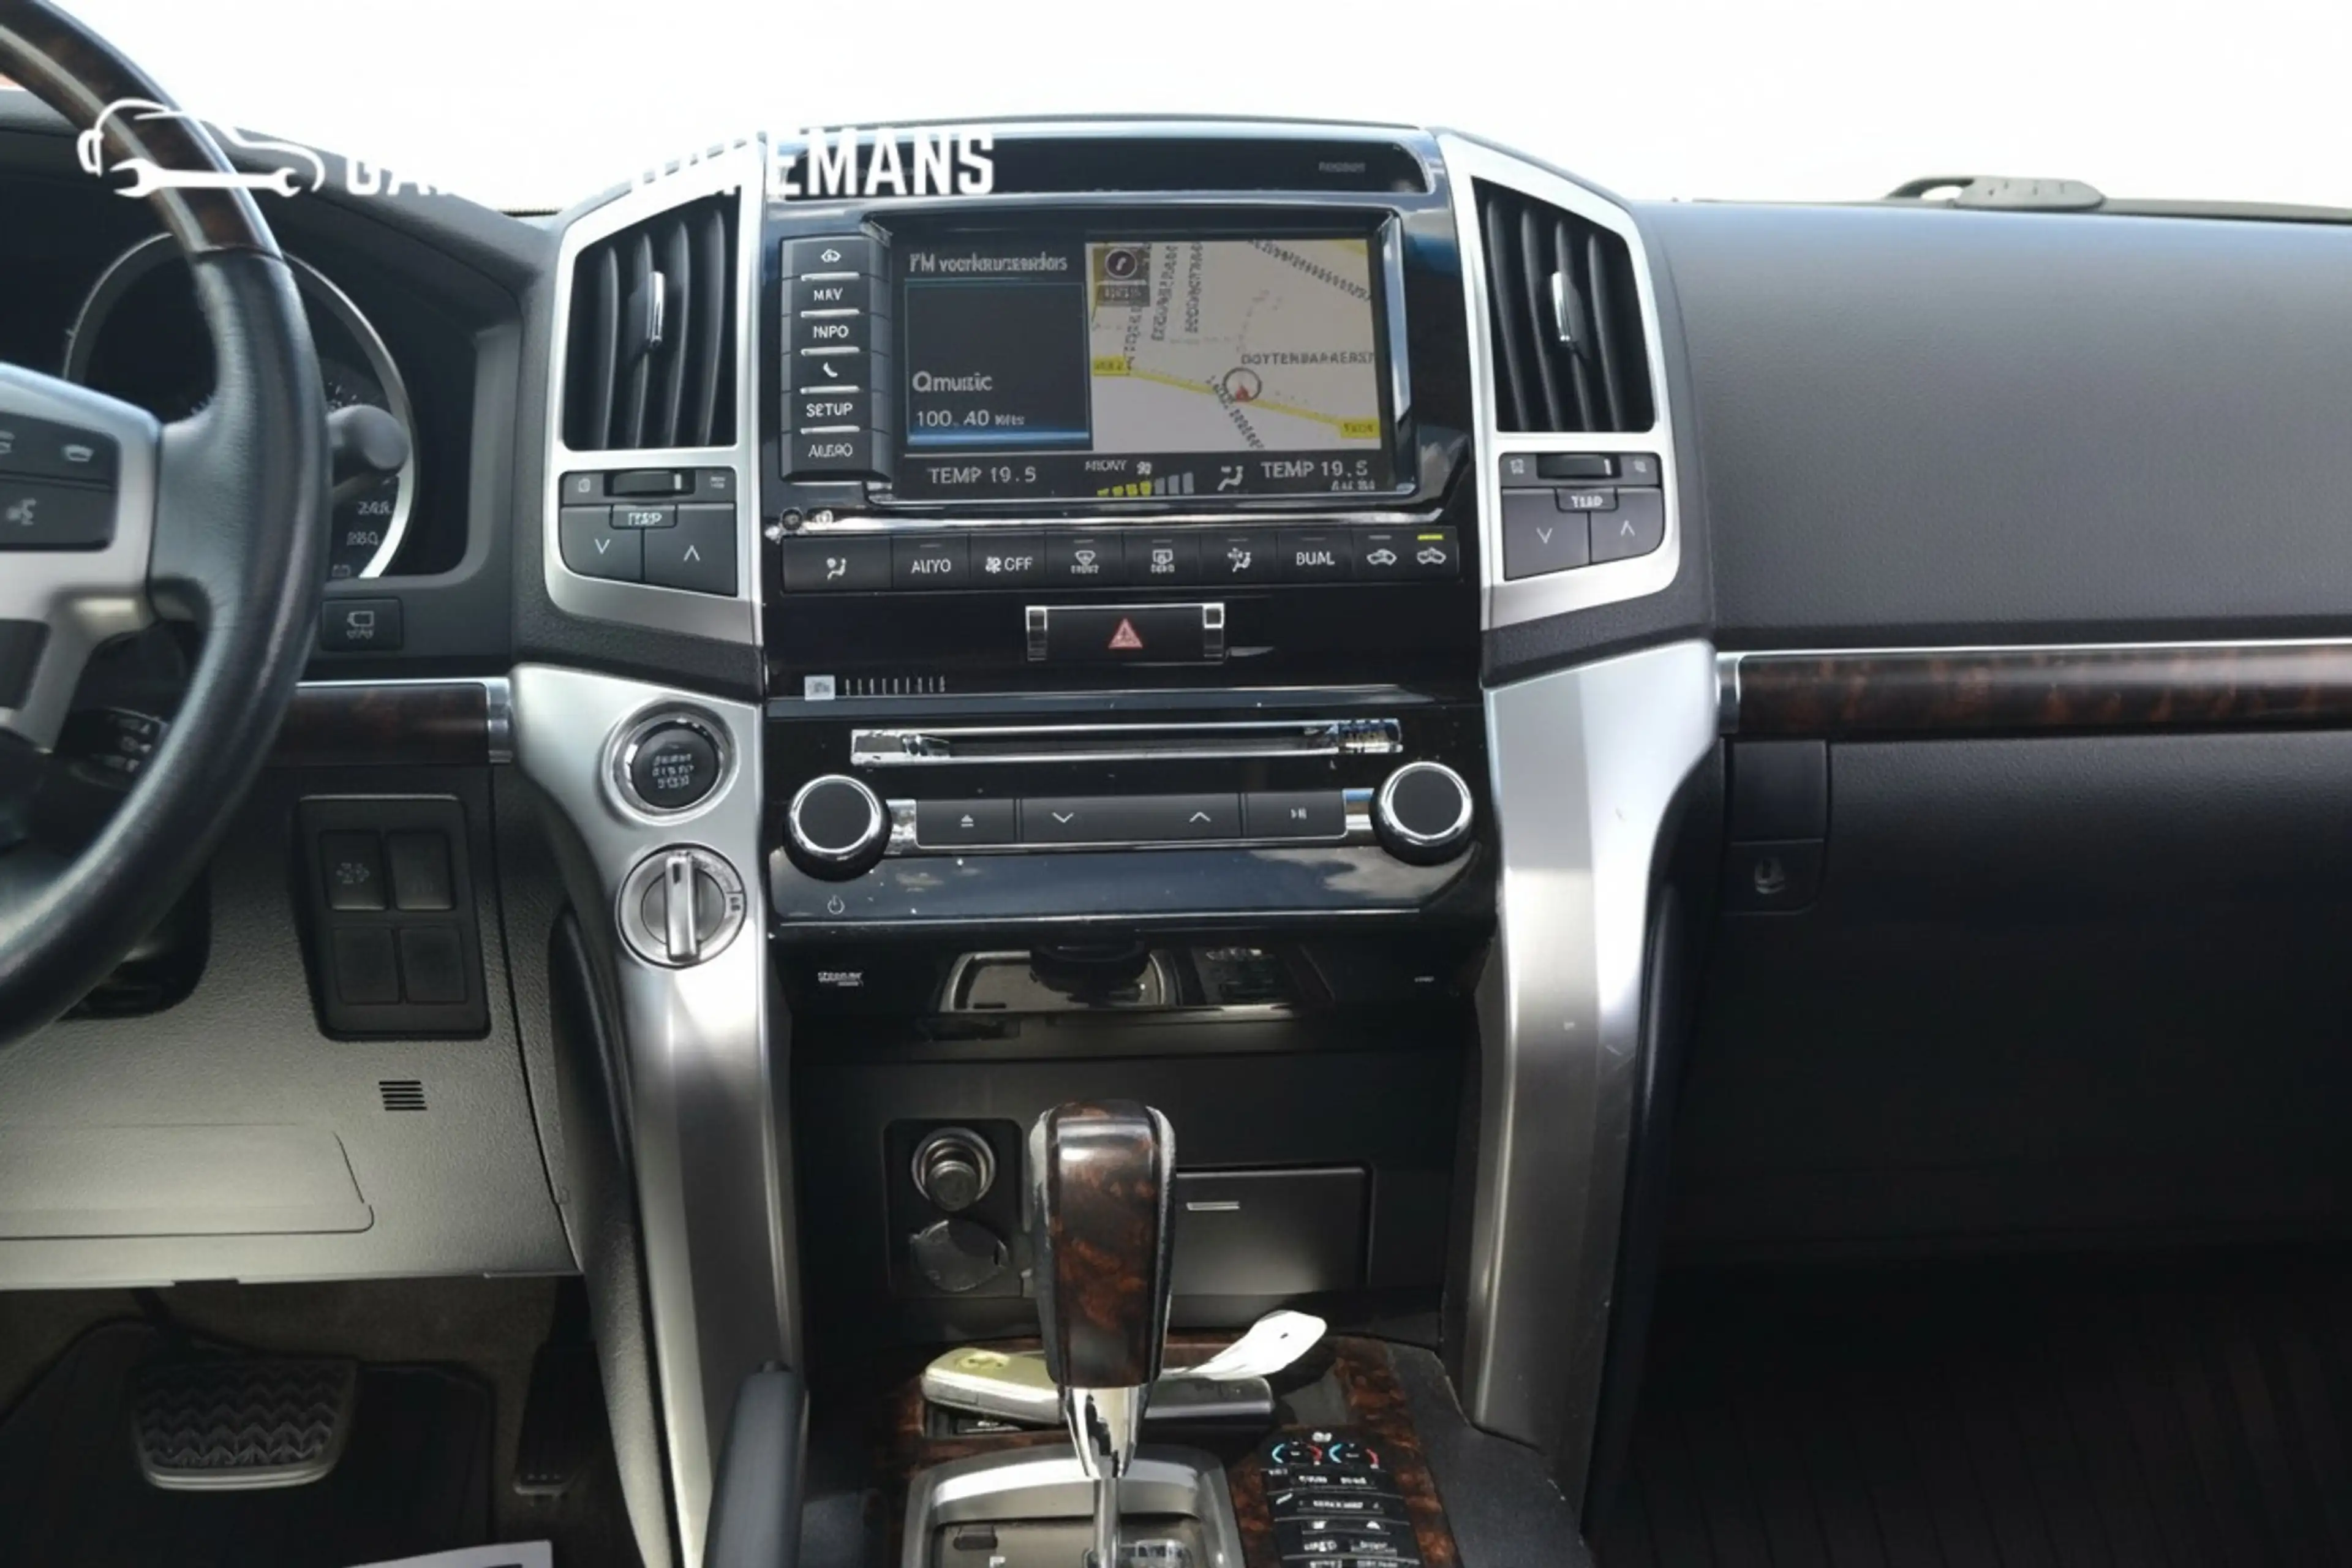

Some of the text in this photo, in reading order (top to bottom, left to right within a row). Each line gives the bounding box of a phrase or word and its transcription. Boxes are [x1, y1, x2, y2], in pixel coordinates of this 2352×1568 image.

[806, 403, 853, 417] SETUP
[927, 466, 982, 484] TEMP
[1261, 461, 1314, 478] TEMP
